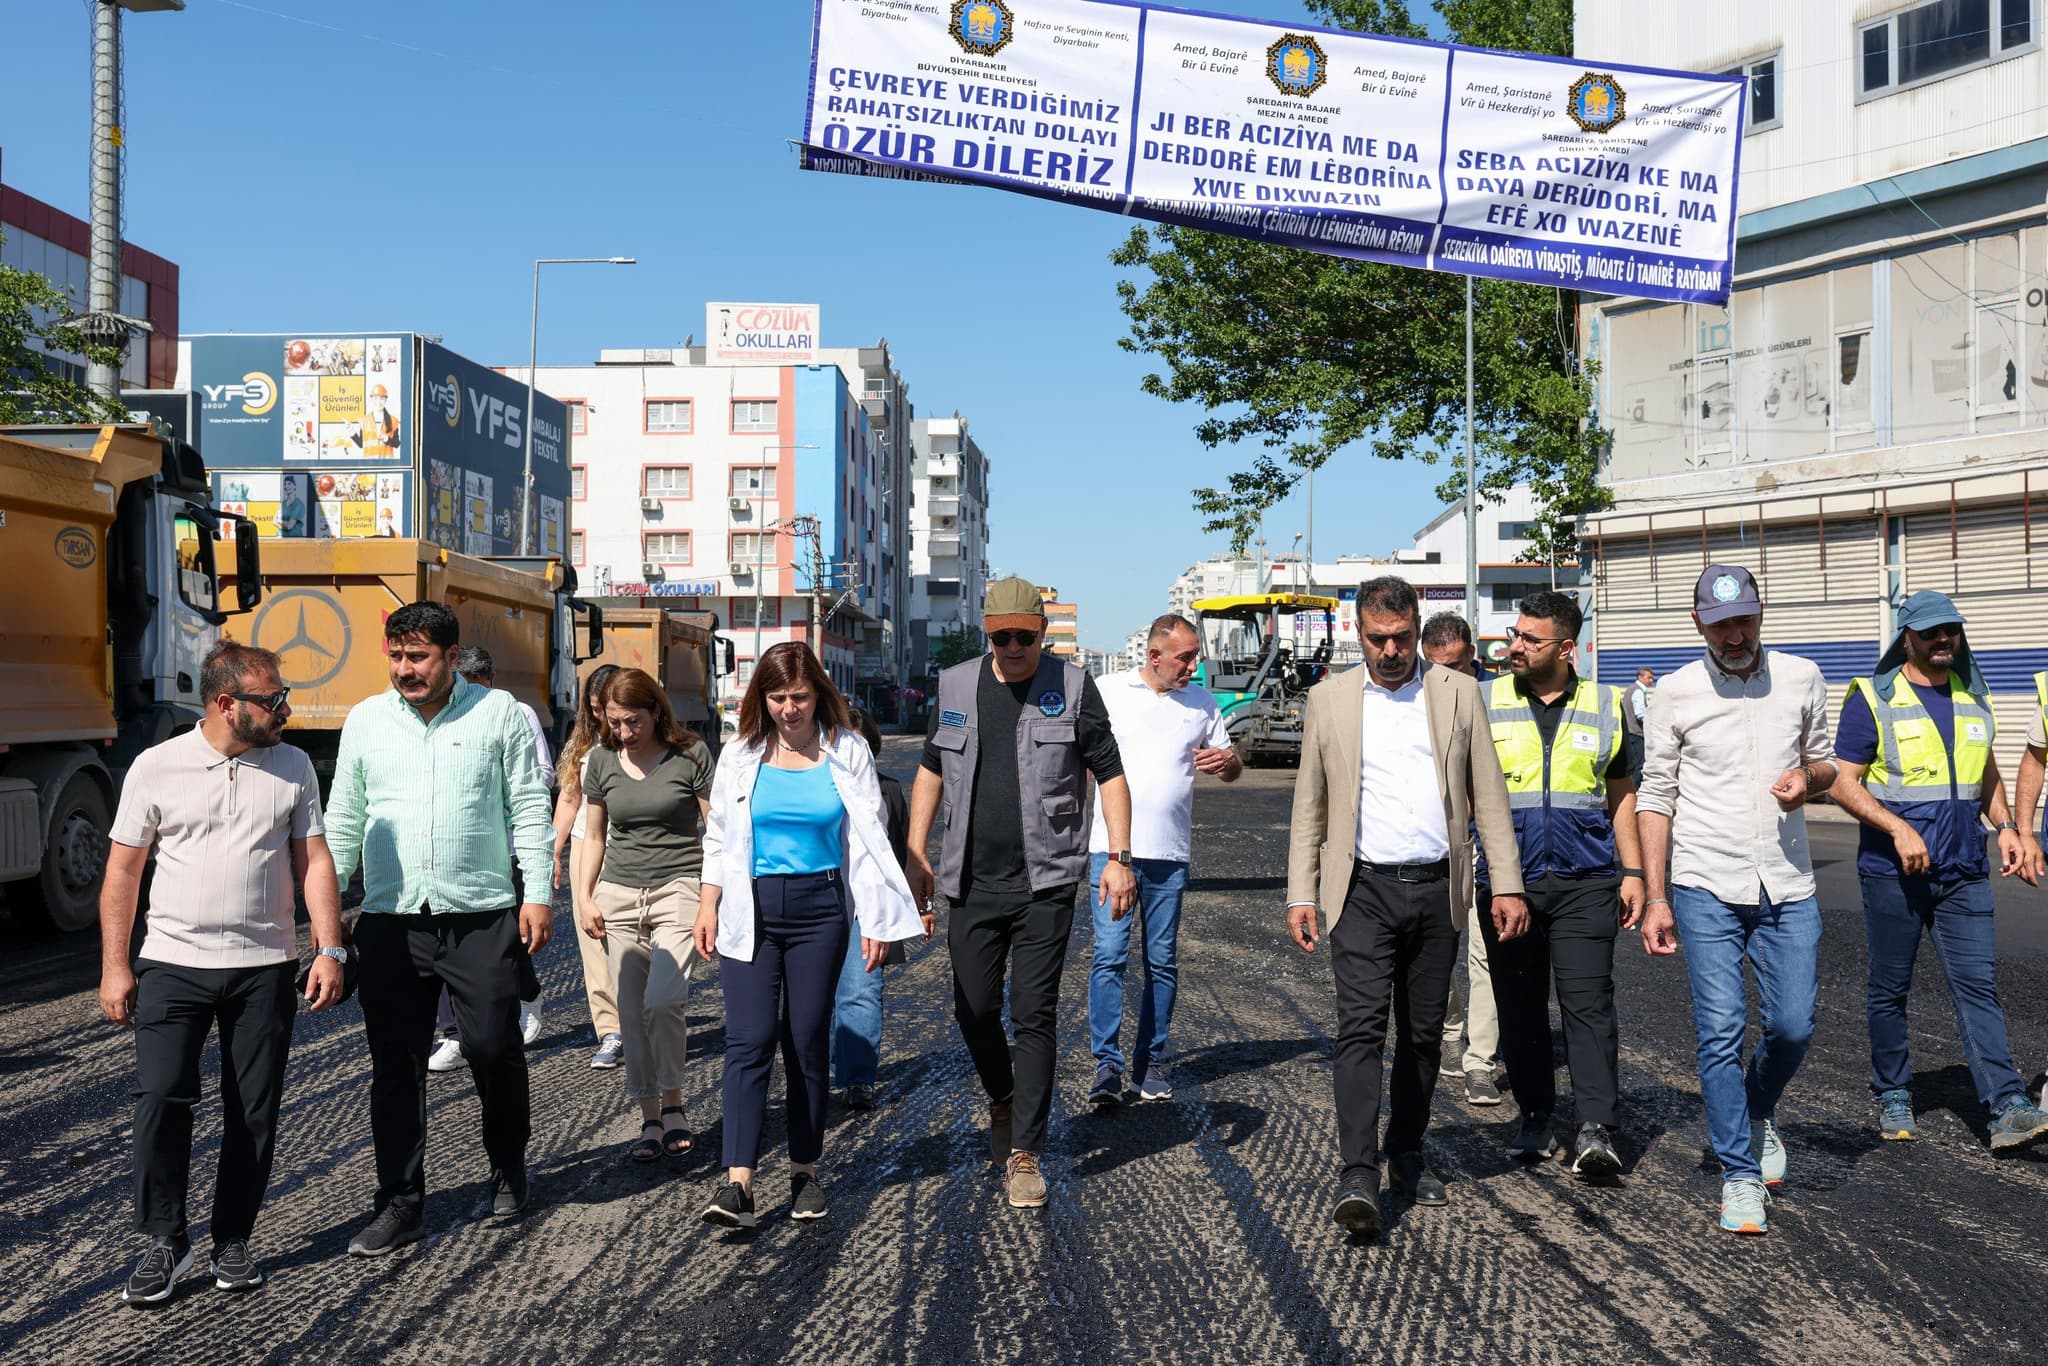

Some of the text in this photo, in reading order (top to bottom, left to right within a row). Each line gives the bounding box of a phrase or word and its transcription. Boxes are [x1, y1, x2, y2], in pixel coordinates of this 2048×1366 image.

[861, 7, 908, 23] Diyarbakır
[913, 2, 940, 15] Kenti,
[1023, 18, 1130, 43] Hafıza ve Sevginin Kenti,
[1053, 34, 1100, 50] Diyarbakır
[950, 55, 1007, 72] DİYARBAKIR
[1173, 42, 1248, 62] Amed, Bajarê
[917, 62, 1037, 88] BÜYÜKŞEHİR BELEDİYESİ
[1181, 58, 1239, 76] Bir û Evînê
[1353, 66, 1427, 85] Amed, Bajarê
[828, 67, 1120, 124] ÇEVREYE VERDİĞİMİZ
[1361, 83, 1418, 100] Bir û Evînê
[1466, 82, 1500, 97] Amed,
[827, 95, 1117, 148] RAHATSIZLIKTAN DOLAYI
[1288, 113, 1295, 121] A
[1543, 107, 1556, 119] yo
[1642, 103, 1673, 115] Amed,
[1150, 112, 1419, 163] JI BER ACIZÎYA ME DA
[1714, 123, 1727, 135] yo
[822, 117, 1115, 187] ÖZÜR DİLERİZ
[1143, 140, 1432, 190] DERDORÊ EM LÊBORÎNA
[1456, 149, 1719, 195] SEBA ACIZÎYA KE MA
[1191, 177, 1381, 207] XWE DIXWAZIN
[1456, 176, 1718, 223] DAYA DERÛDORÎ, MA
[1310, 212, 1321, 238] Û
[1388, 225, 1424, 254] RÊYAN
[1486, 203, 1683, 249] EFÊ XO WAZENÊ
[1441, 236, 1489, 265] SEREKÎYA
[1490, 240, 1534, 270] DAÎREYA
[1586, 251, 1626, 282] MİQATE
[1626, 256, 1635, 283] Û
[1636, 259, 1675, 287] TAMÎRÊ
[1676, 264, 1722, 292] RAYÎRAN
[736, 305, 811, 331] ÇÖZÜM
[736, 333, 812, 349] OKULLARI
[202, 384, 263, 402] YFS
[468, 386, 523, 449] YFS
[533, 438, 560, 464] TEKSTİL
